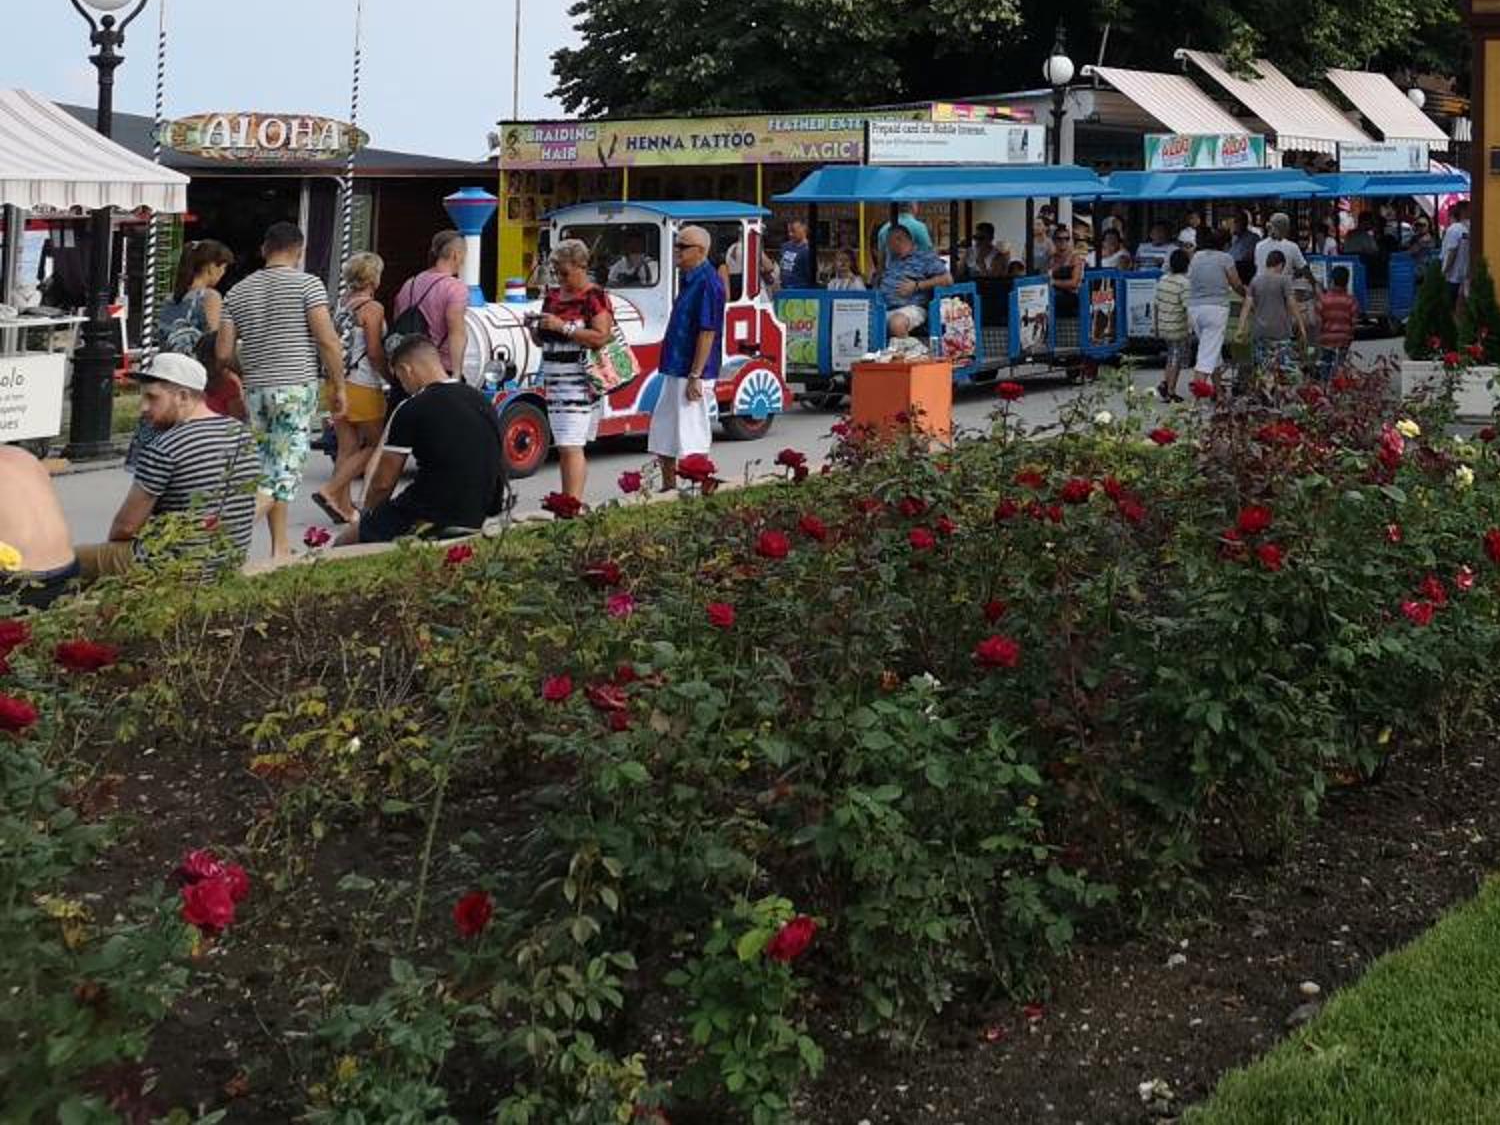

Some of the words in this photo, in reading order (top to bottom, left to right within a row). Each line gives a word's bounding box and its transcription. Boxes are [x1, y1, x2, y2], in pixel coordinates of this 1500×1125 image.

[202, 115, 341, 150] ALOHA
[526, 128, 597, 144] BRAIDING
[626, 135, 685, 150] HENNA
[691, 132, 756, 148] TATTOO
[541, 145, 577, 161] HAIR
[790, 142, 850, 159] MAGIC
